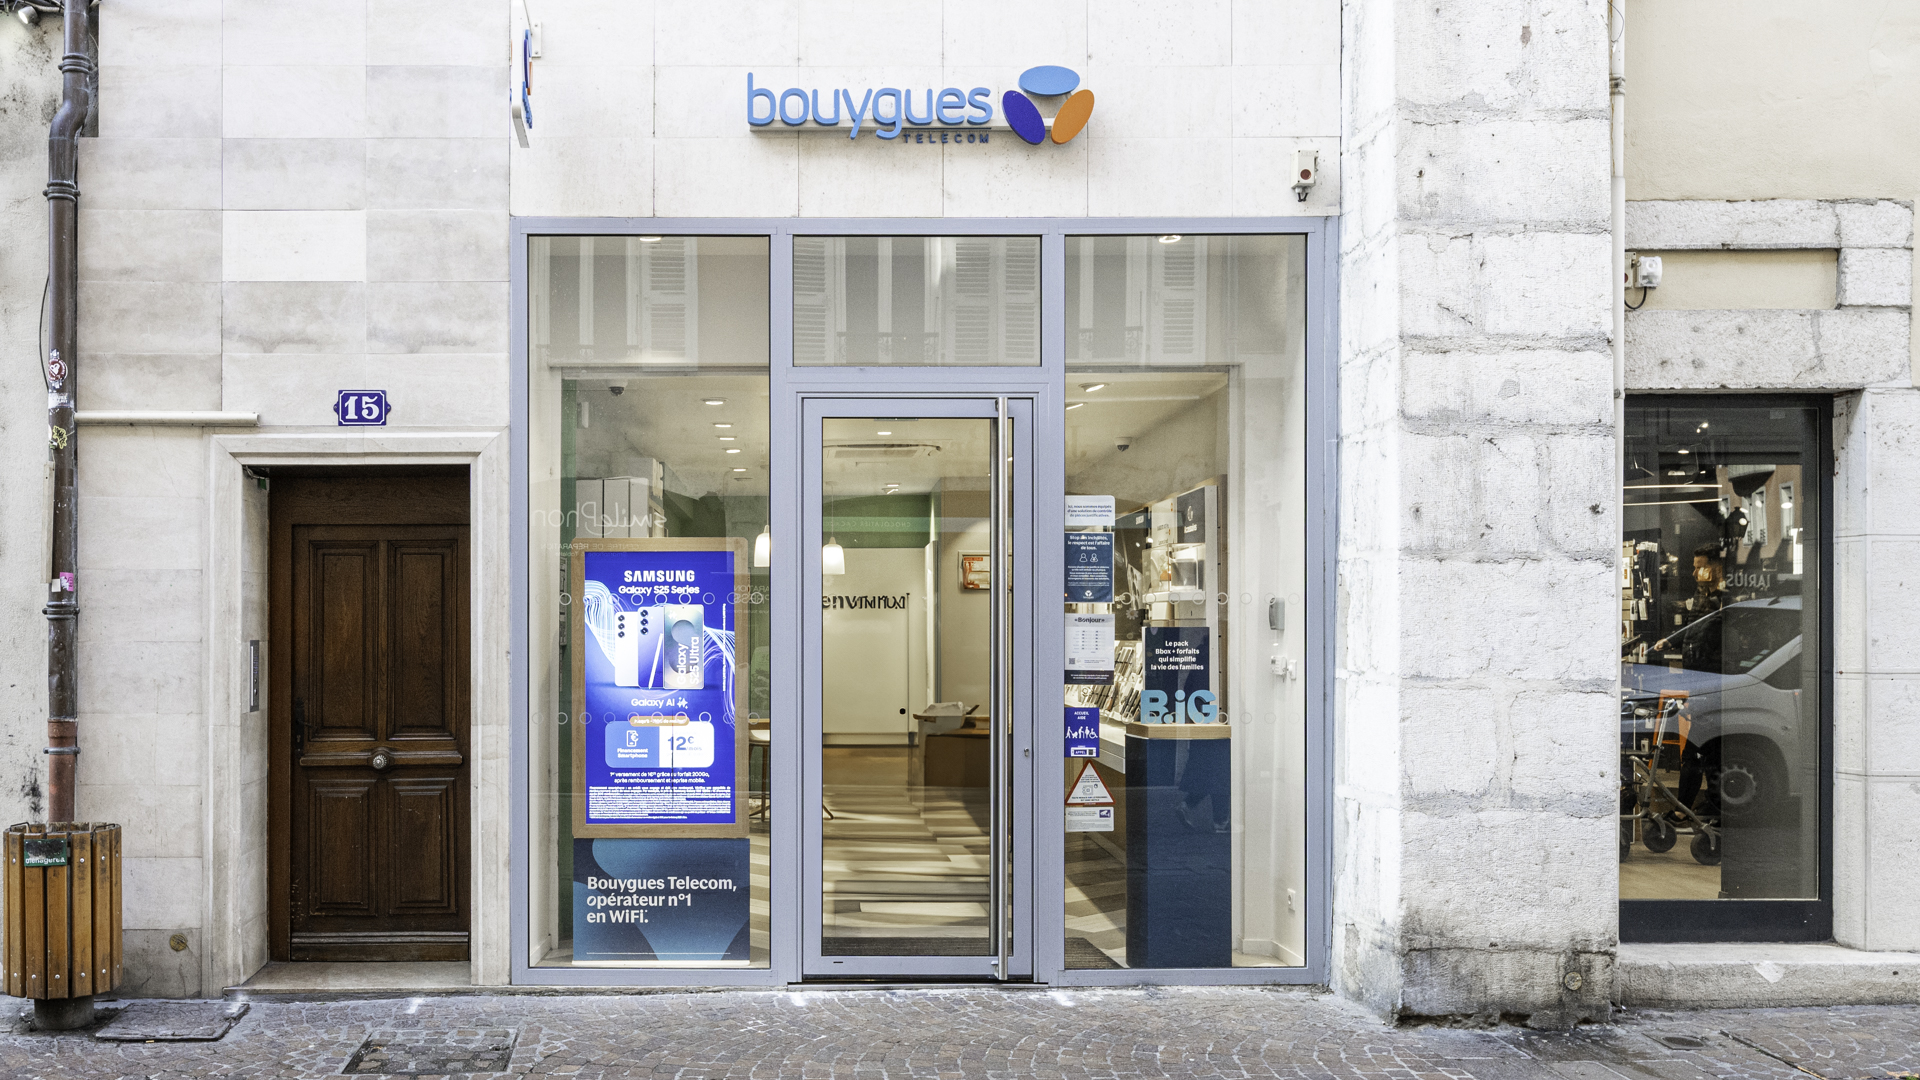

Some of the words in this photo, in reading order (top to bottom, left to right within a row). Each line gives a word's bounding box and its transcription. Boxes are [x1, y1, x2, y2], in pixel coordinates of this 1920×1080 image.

[747, 72, 993, 140] bouygues
[903, 133, 990, 144] TELECOM
[344, 395, 380, 420] 15
[624, 570, 695, 582] SAMSUNG
[618, 585, 652, 597] Galaxy
[653, 585, 670, 594] S25
[671, 584, 700, 594] Series
[689, 636, 700, 664] Ultra
[1173, 640, 1189, 648] pack
[677, 643, 689, 685] Galaxy
[1169, 656, 1197, 664] simplifie
[689, 664, 700, 685] S25
[631, 698, 664, 709] Galaxy
[666, 698, 675, 707] AI
[587, 876, 665, 892] Bouygues
[667, 876, 737, 892] Telecom,
[586, 893, 665, 909] opérateur
[668, 893, 692, 907] n°1
[586, 911, 606, 923] en
